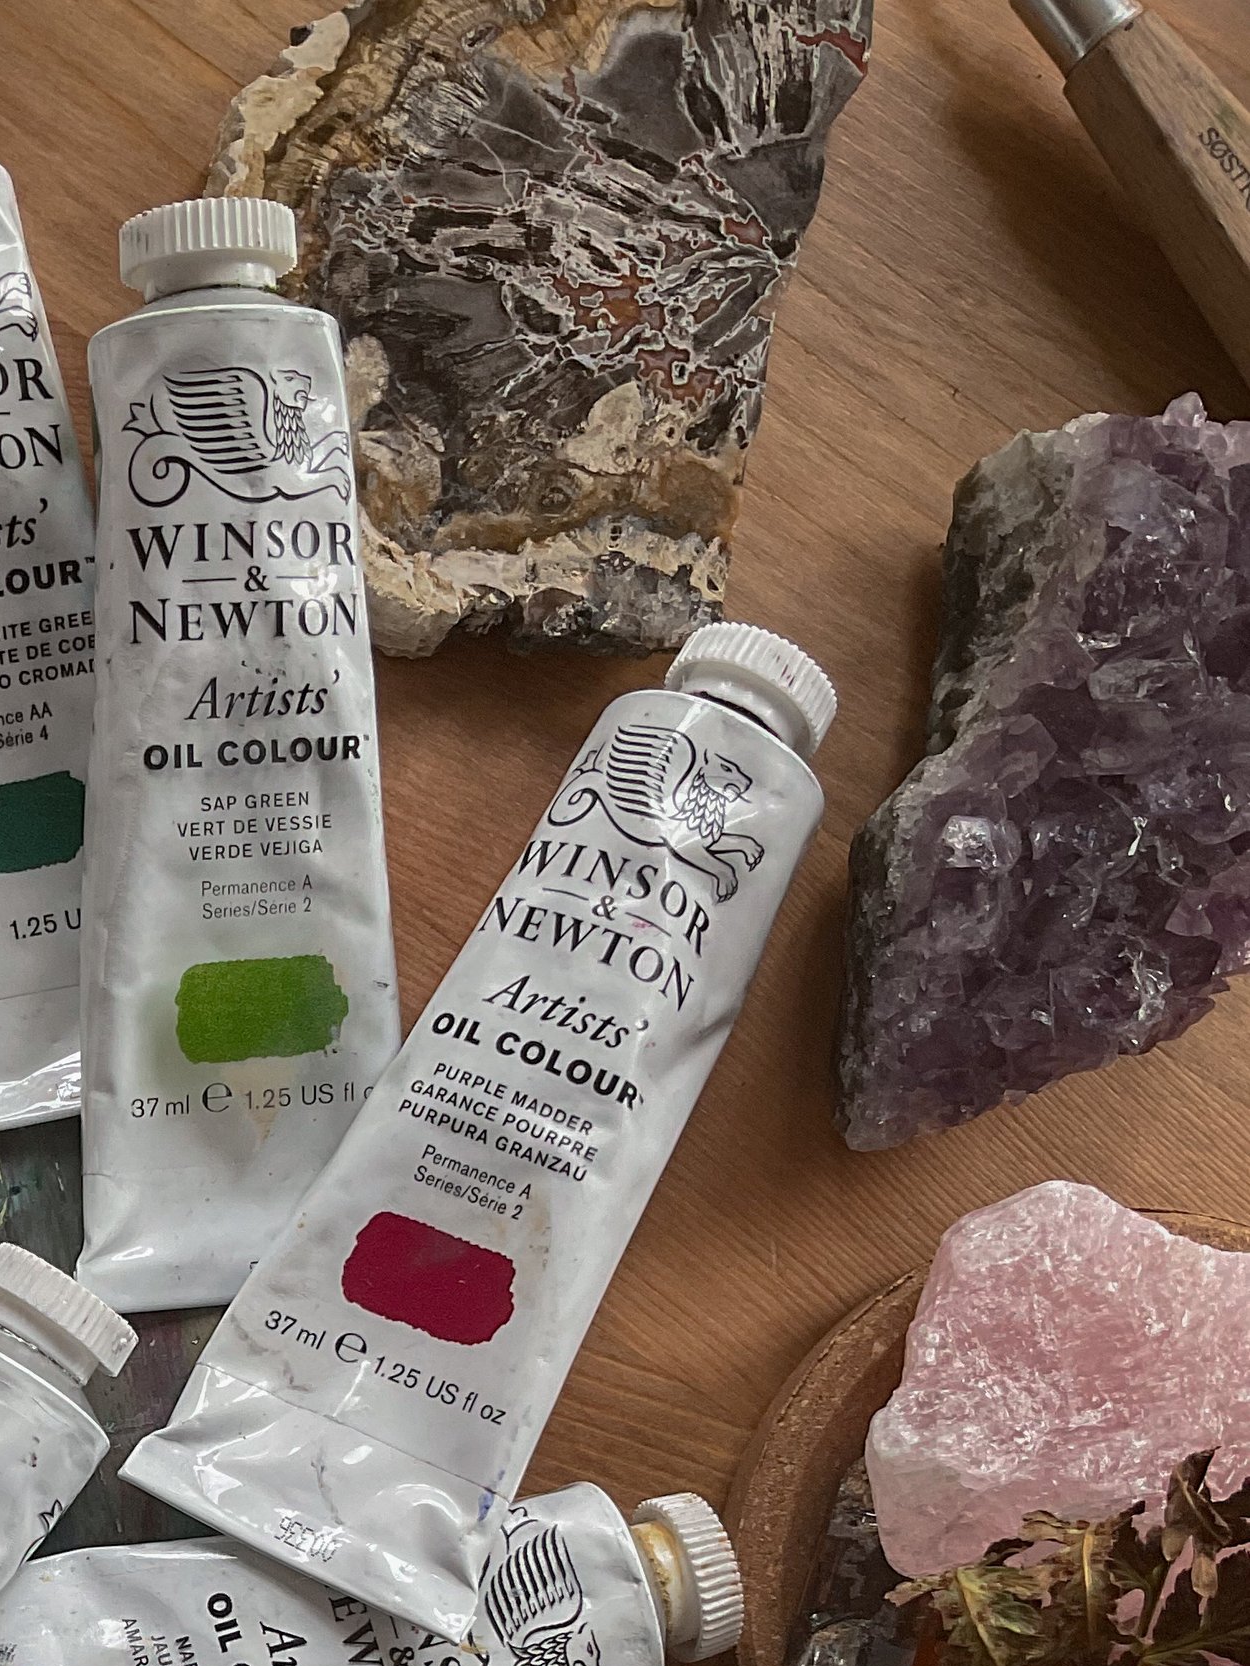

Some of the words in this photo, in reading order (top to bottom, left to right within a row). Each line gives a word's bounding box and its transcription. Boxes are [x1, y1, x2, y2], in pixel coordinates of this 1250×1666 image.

[126, 520, 357, 572] WINSOR
[244, 565, 270, 593] &
[38, 609, 94, 636] GREE
[130, 592, 358, 645] NEWTON
[25, 640, 52, 661] DE
[185, 668, 342, 721] Artists'
[143, 741, 202, 771] OIL
[176, 818, 227, 839] VERT
[232, 816, 258, 835] DE
[264, 813, 333, 833] VESSIE
[200, 795, 237, 813] SAP
[245, 791, 311, 811] GREEN
[188, 840, 254, 862] VERDE
[259, 837, 324, 857] VEJIGA
[516, 840, 710, 958] WINSOR
[592, 894, 618, 921] &
[479, 896, 695, 1011] NEWTON
[431, 1012, 481, 1047] OIL
[483, 975, 650, 1050] Artists'
[398, 1100, 490, 1147] PURPURA
[410, 1079, 499, 1126] GARANCE
[502, 1113, 598, 1162] POURPRE
[432, 1062, 507, 1101] PURPLE
[510, 1090, 594, 1137] MADDER
[374, 1354, 420, 1390] 1.25
[425, 1375, 460, 1405] US
[464, 1392, 479, 1414] fl
[480, 1402, 507, 1427] oz
[206, 1592, 244, 1655] OIL
